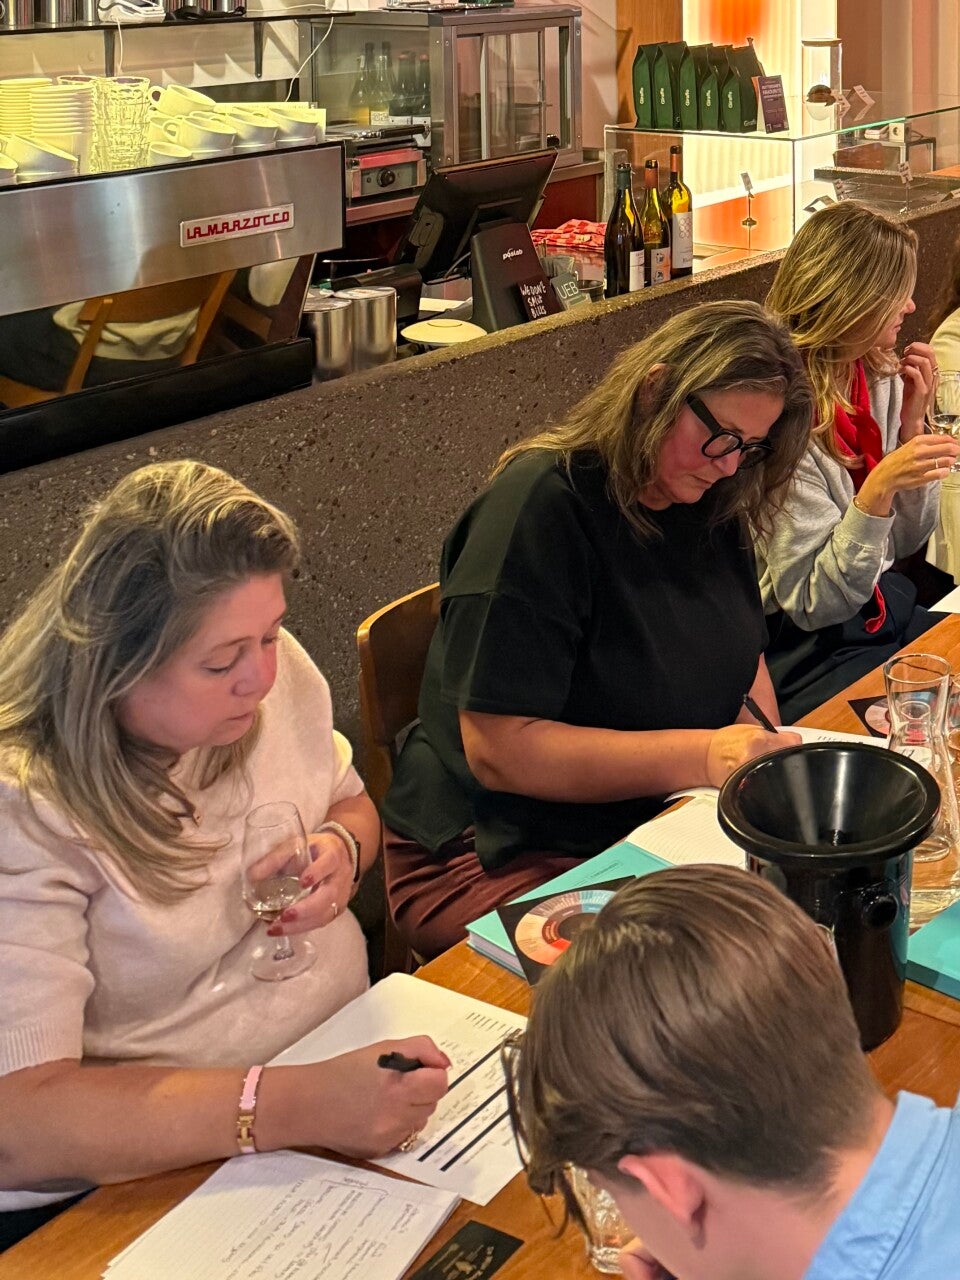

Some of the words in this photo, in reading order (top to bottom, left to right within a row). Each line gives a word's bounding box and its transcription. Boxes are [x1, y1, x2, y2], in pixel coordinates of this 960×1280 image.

[186, 226, 202, 240] LA
[207, 211, 290, 237] MARZOCCO
[556, 281, 579, 299] UEB
